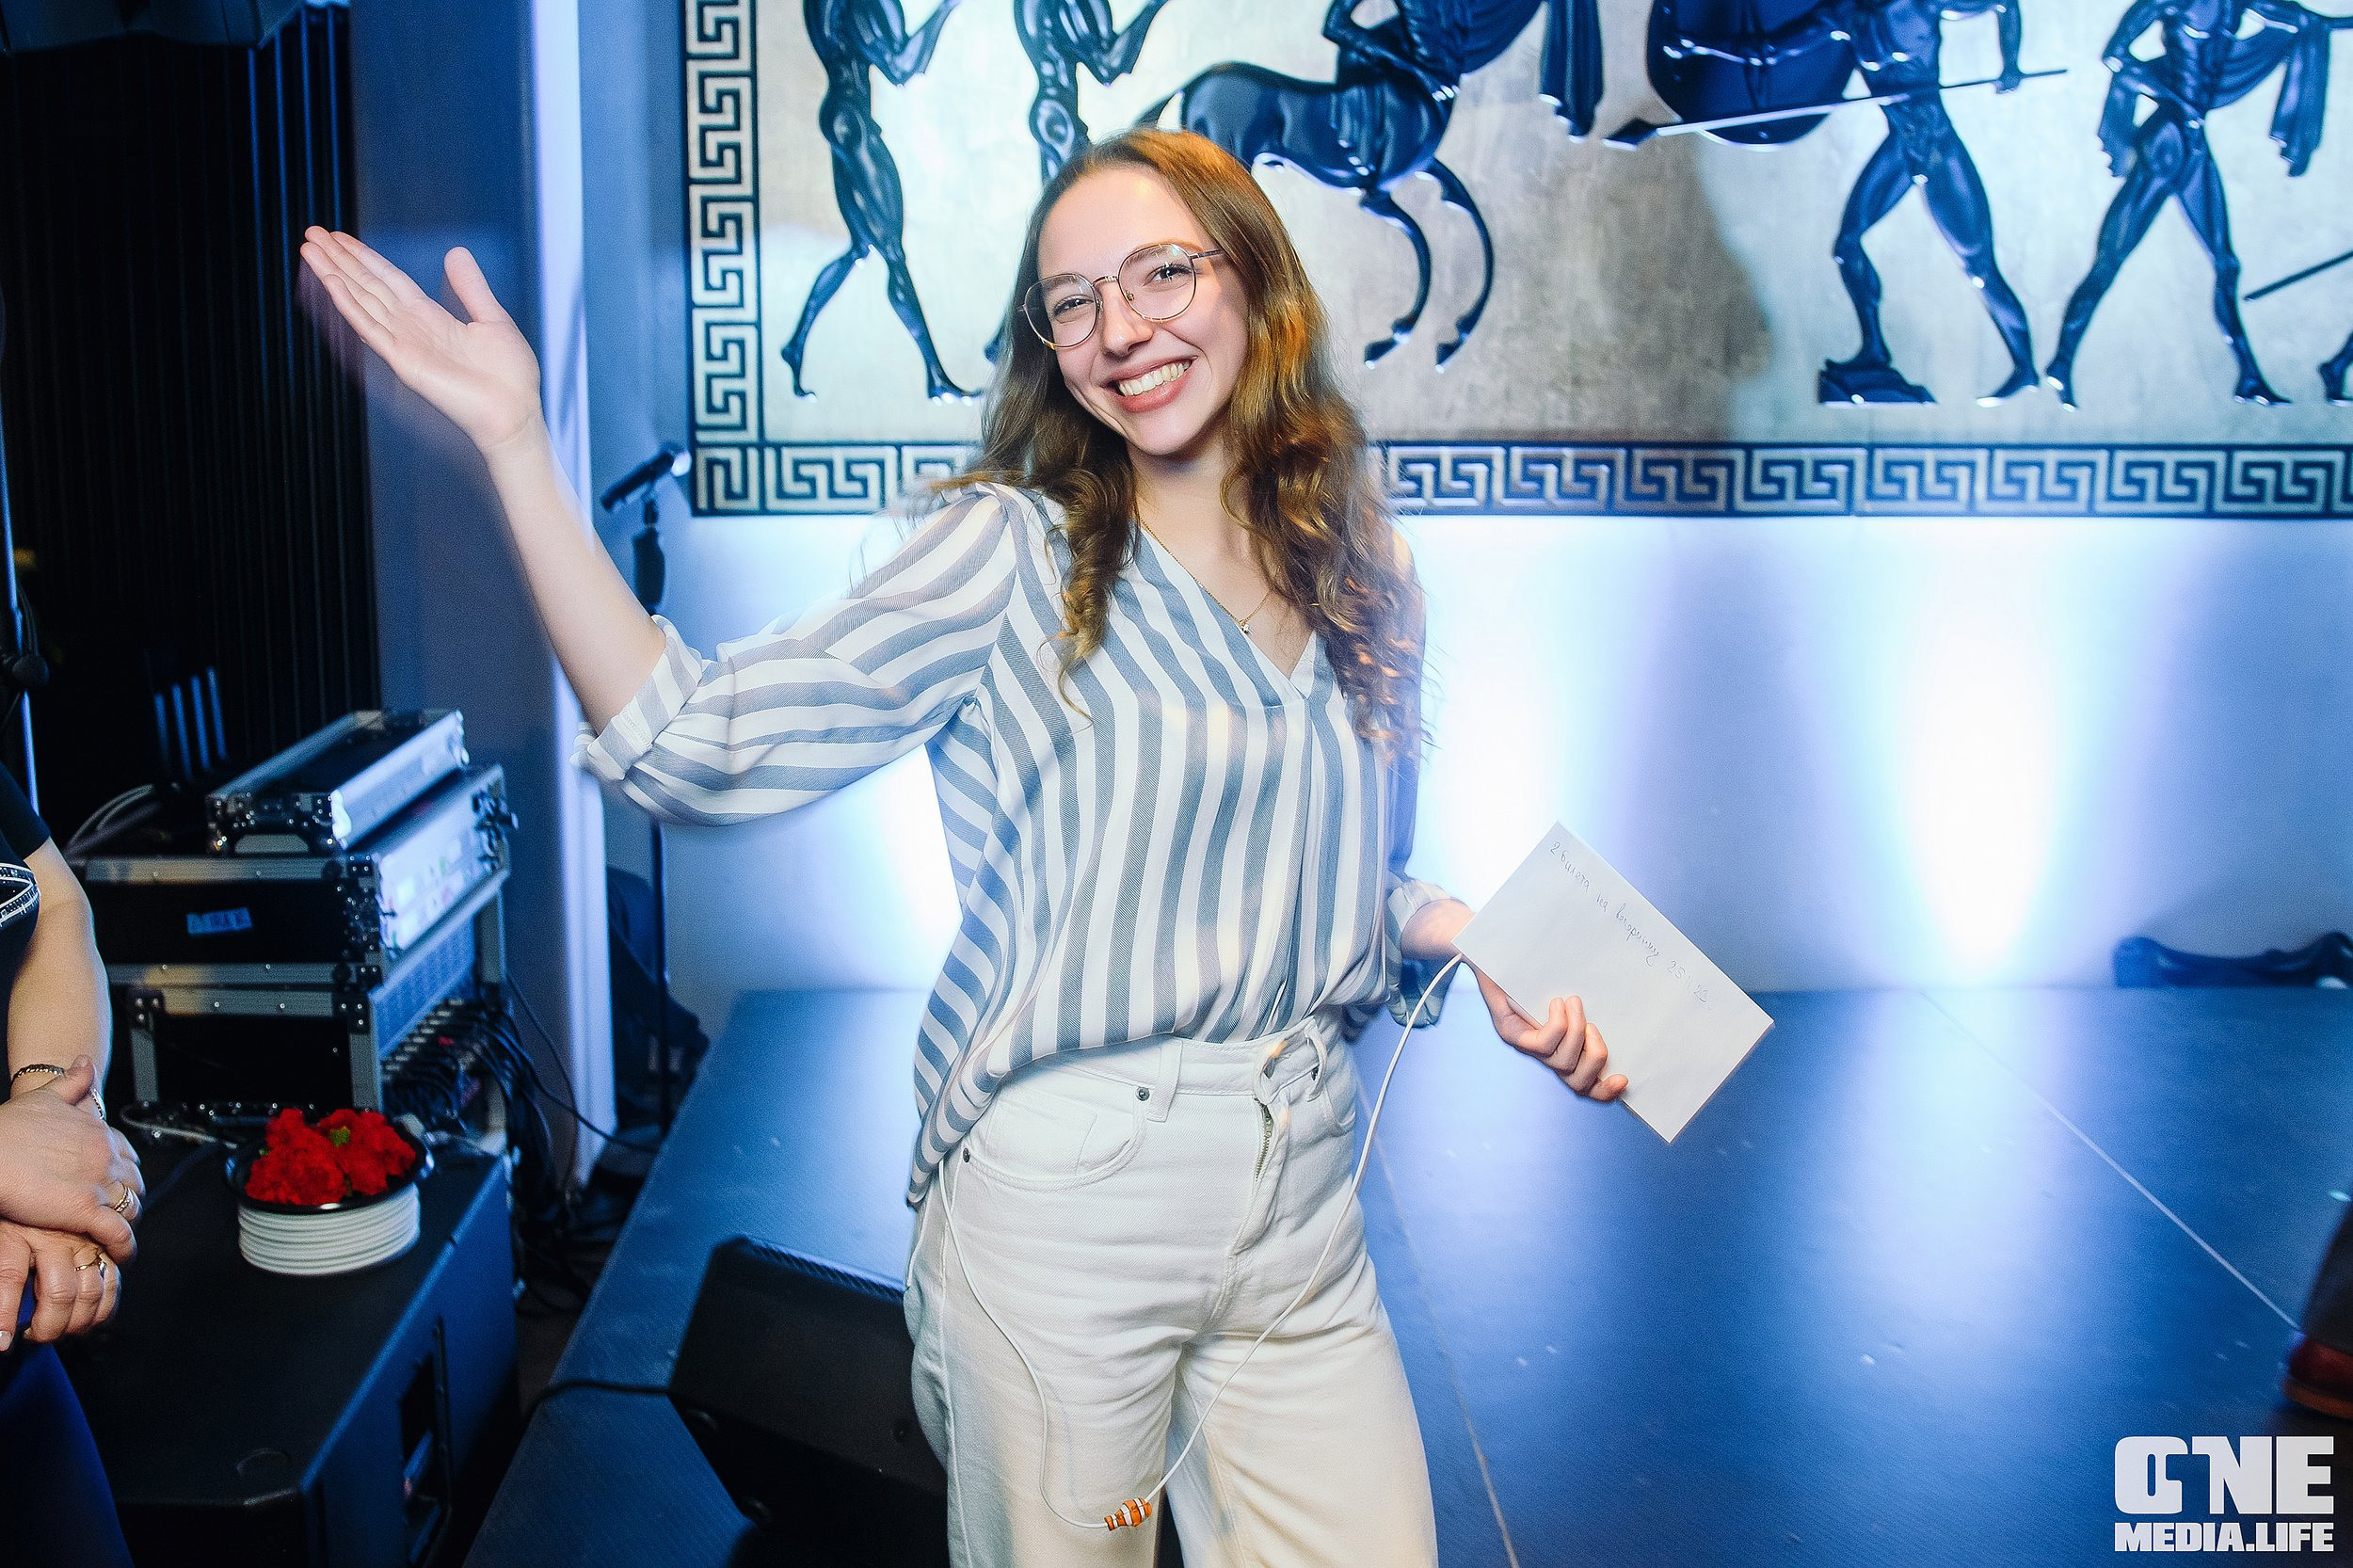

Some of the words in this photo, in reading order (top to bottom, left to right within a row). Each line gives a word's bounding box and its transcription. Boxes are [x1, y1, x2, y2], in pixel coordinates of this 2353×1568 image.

[1550, 841, 1561, 856] 2
[1561, 850, 1590, 893] билета
[1596, 893, 1609, 912] на
